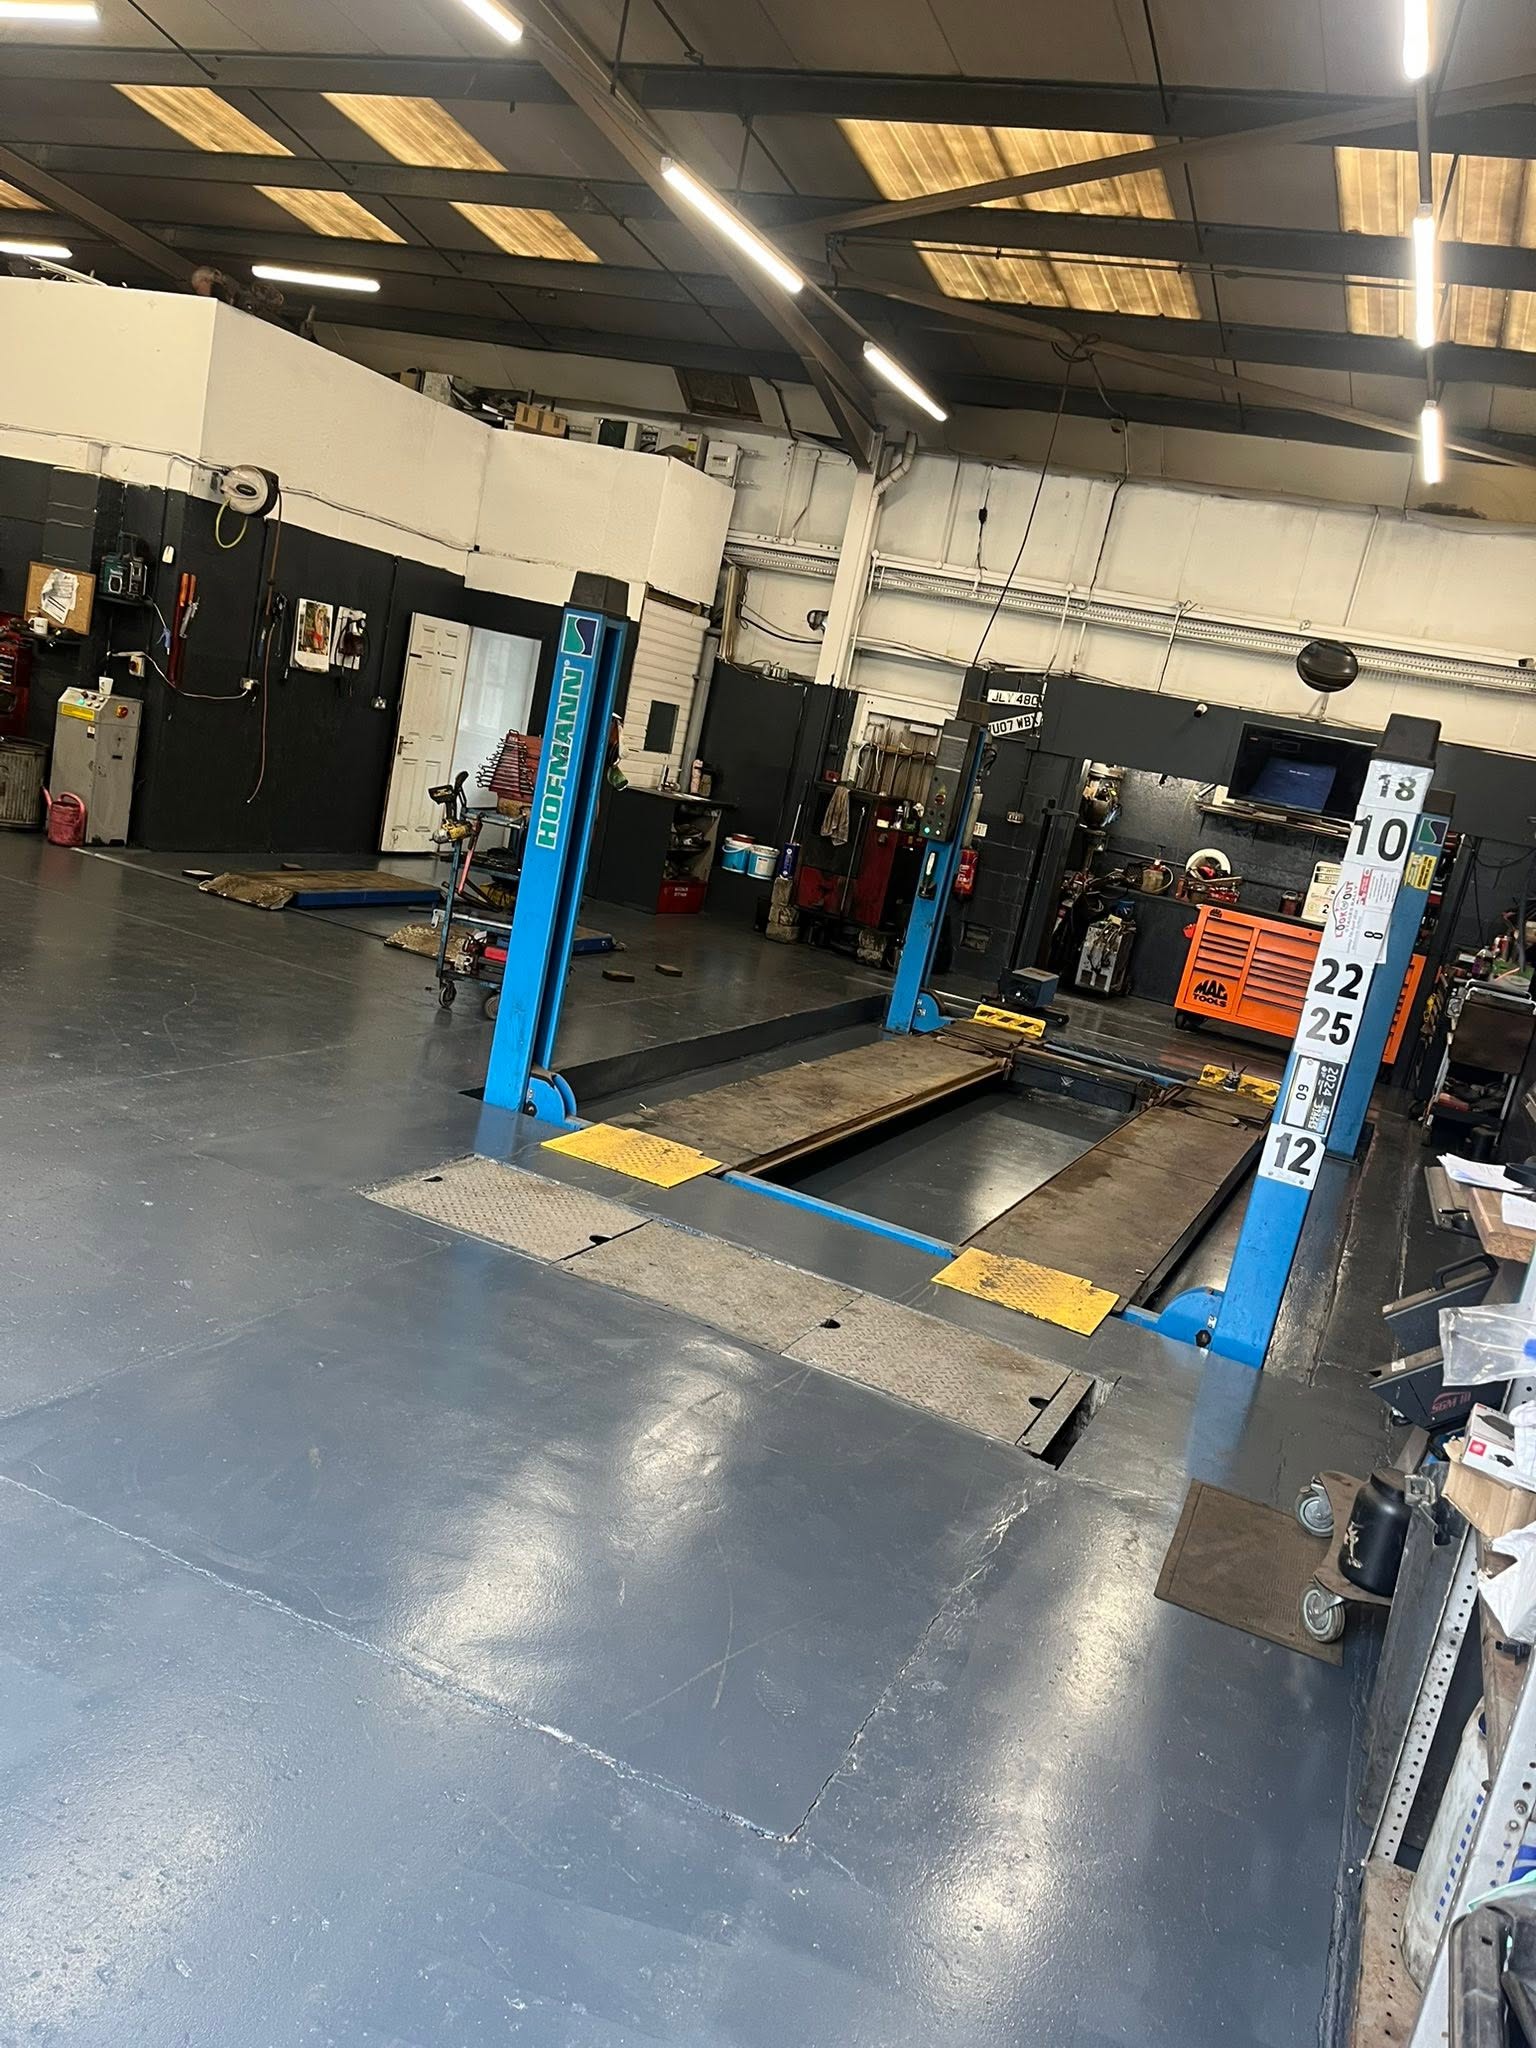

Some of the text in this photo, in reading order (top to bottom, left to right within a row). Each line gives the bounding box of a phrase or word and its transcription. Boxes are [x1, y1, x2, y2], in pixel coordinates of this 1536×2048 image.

[992, 692, 1014, 703] JLY
[536, 666, 584, 850] HOFMANN
[1378, 774, 1416, 801] 18
[1354, 815, 1408, 861] 10
[1342, 880, 1354, 900] OUT
[1364, 931, 1383, 940] 8
[1193, 980, 1228, 1001] MAC
[1314, 958, 1364, 1000] 22
[1193, 993, 1227, 1007] TOOLS
[1305, 1007, 1353, 1046] 25
[1296, 1083, 1309, 1101] 60
[1321, 1067, 1339, 1097] 2024
[1273, 1132, 1317, 1176] 12
